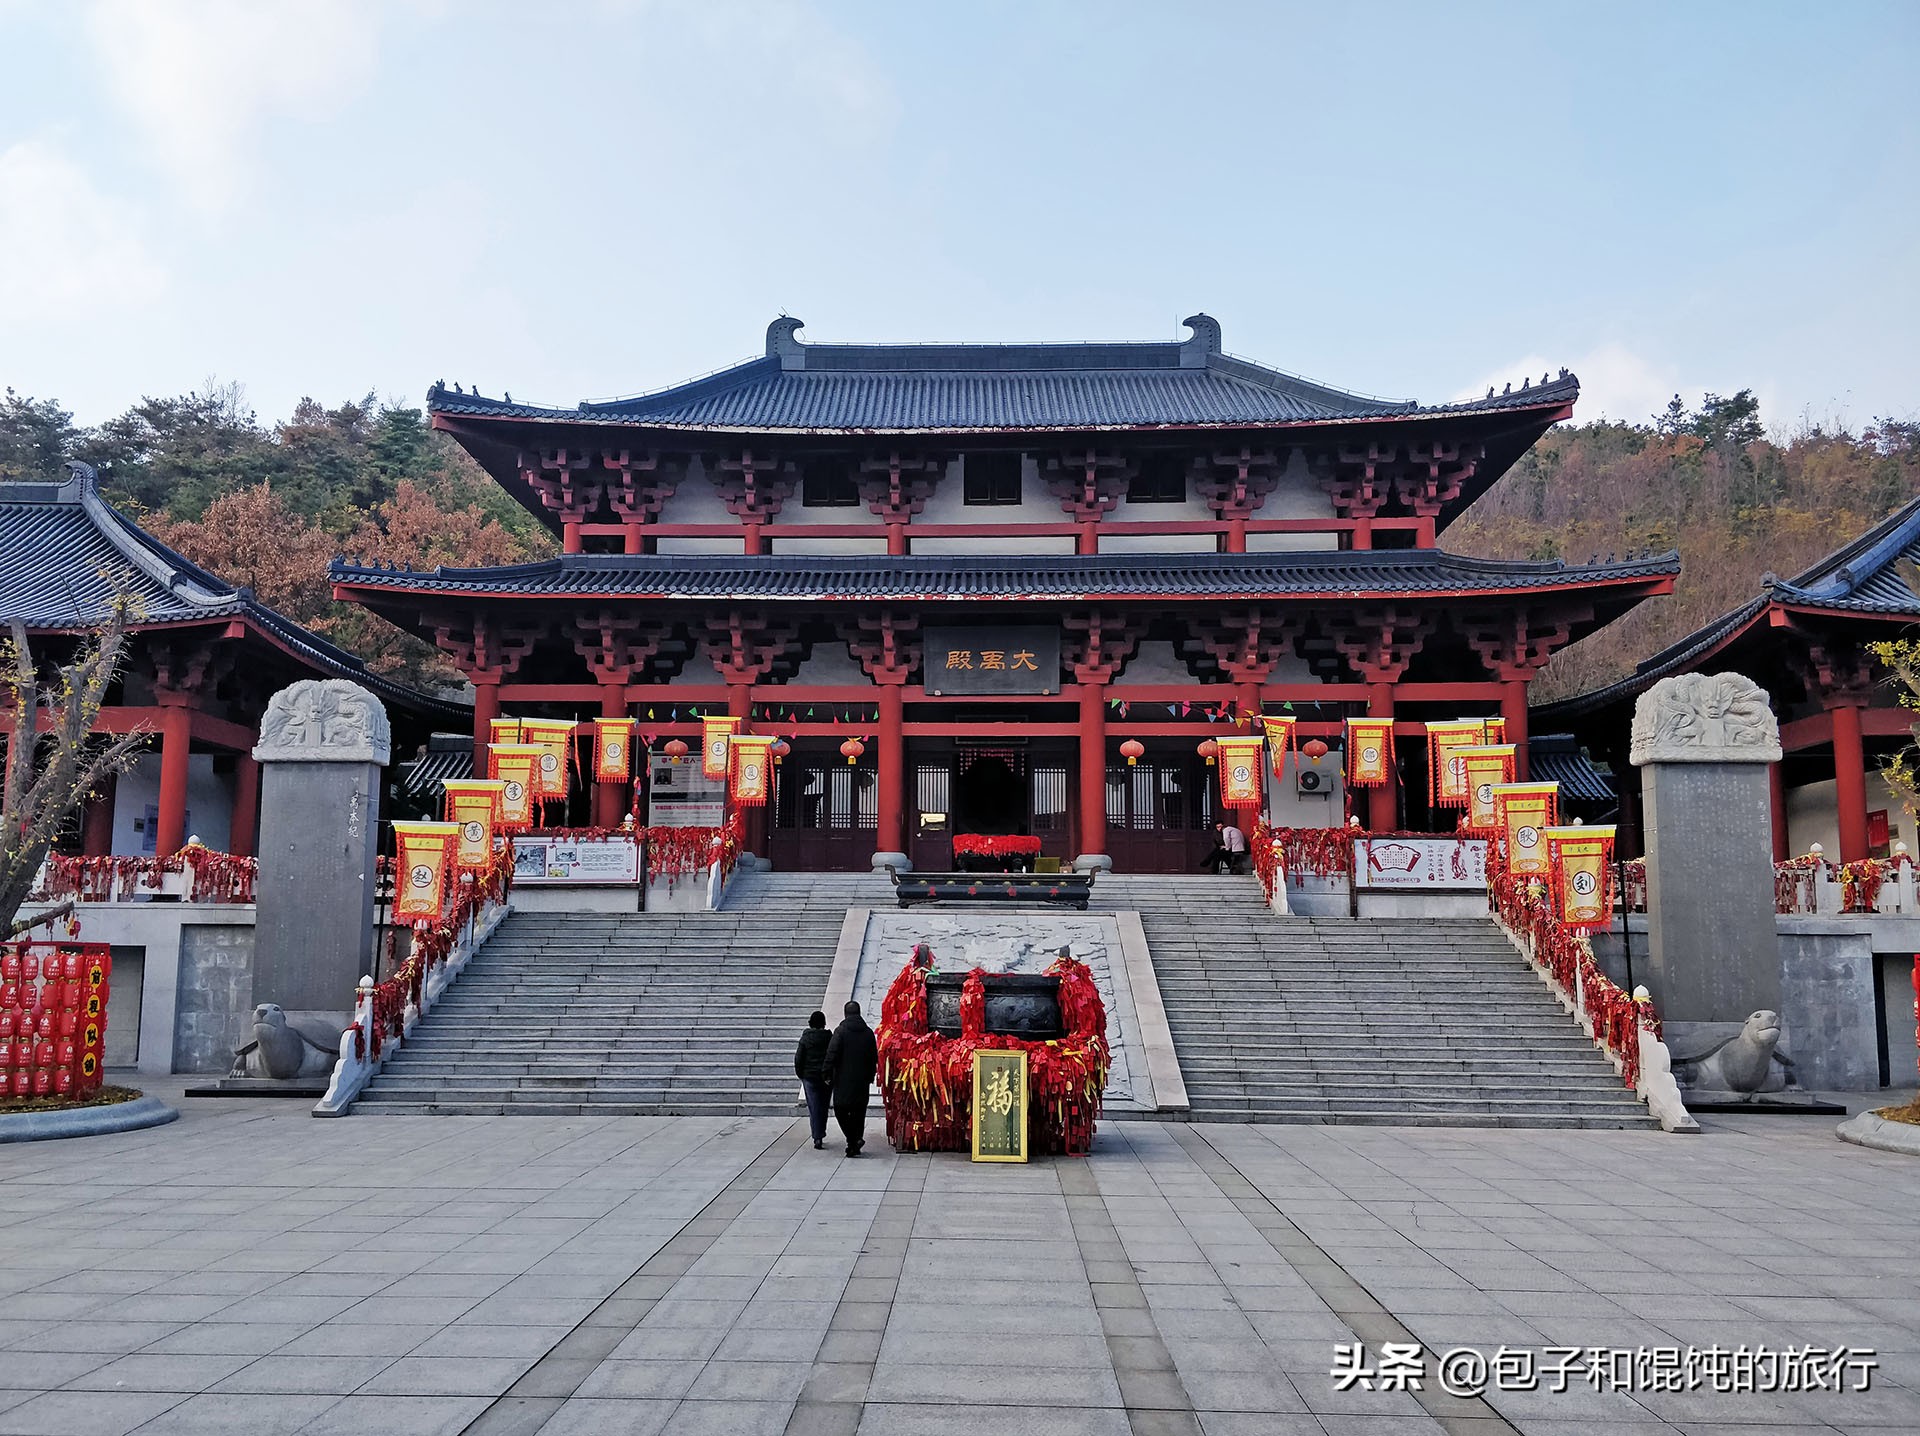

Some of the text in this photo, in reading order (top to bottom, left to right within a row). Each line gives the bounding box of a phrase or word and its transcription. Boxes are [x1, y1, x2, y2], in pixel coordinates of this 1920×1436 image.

[1519, 828, 1536, 843] 耿
[412, 867, 431, 884] 赵
[1575, 874, 1593, 892] 刘
[986, 1069, 1013, 1116] 福
